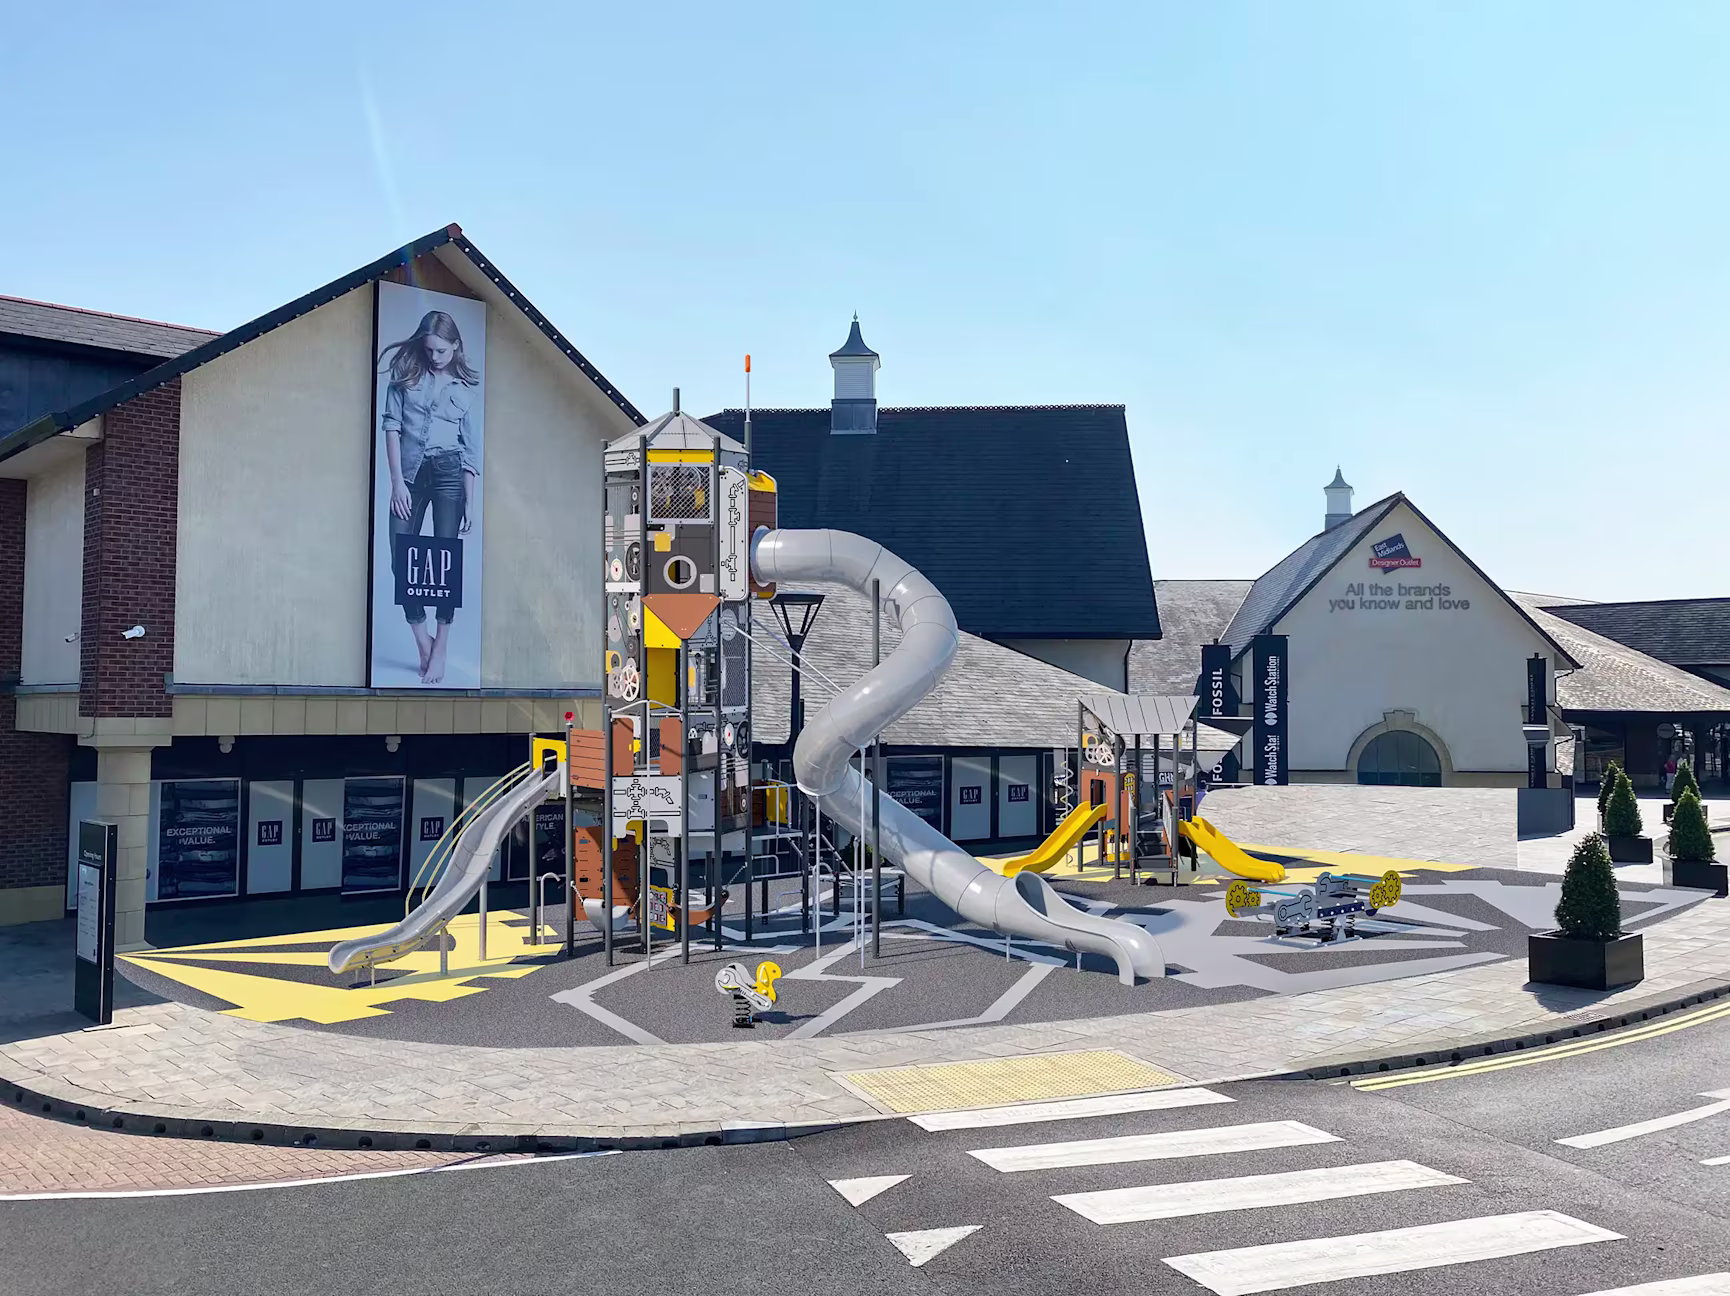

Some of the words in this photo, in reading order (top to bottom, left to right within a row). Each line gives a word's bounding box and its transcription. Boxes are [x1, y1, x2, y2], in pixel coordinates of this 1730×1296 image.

[1374, 542, 1388, 552] East
[1377, 542, 1405, 558] Midlands
[407, 546, 452, 586] GAP
[1372, 559, 1399, 568] Designer
[1400, 559, 1419, 567] Outlet
[407, 587, 451, 598] OUTLET
[1345, 583, 1364, 596] All
[1369, 583, 1393, 596] the
[1398, 583, 1451, 596] brands
[1329, 599, 1355, 613] you
[1360, 597, 1400, 610] know
[1405, 597, 1433, 610] and
[1439, 597, 1470, 610] love
[1212, 667, 1223, 716] FOSSIL
[1212, 757, 1223, 782] FO
[888, 790, 937, 798] CEPTIONAL
[963, 789, 979, 800] GAP
[1011, 786, 1027, 797] GAP
[166, 826, 232, 837] EXCEPTIONAL
[261, 824, 279, 839] GAP
[315, 821, 333, 836] GAP
[343, 821, 396, 831] XCEPTIONAL
[424, 820, 441, 835] GAP
[536, 822, 556, 830] TYLE.
